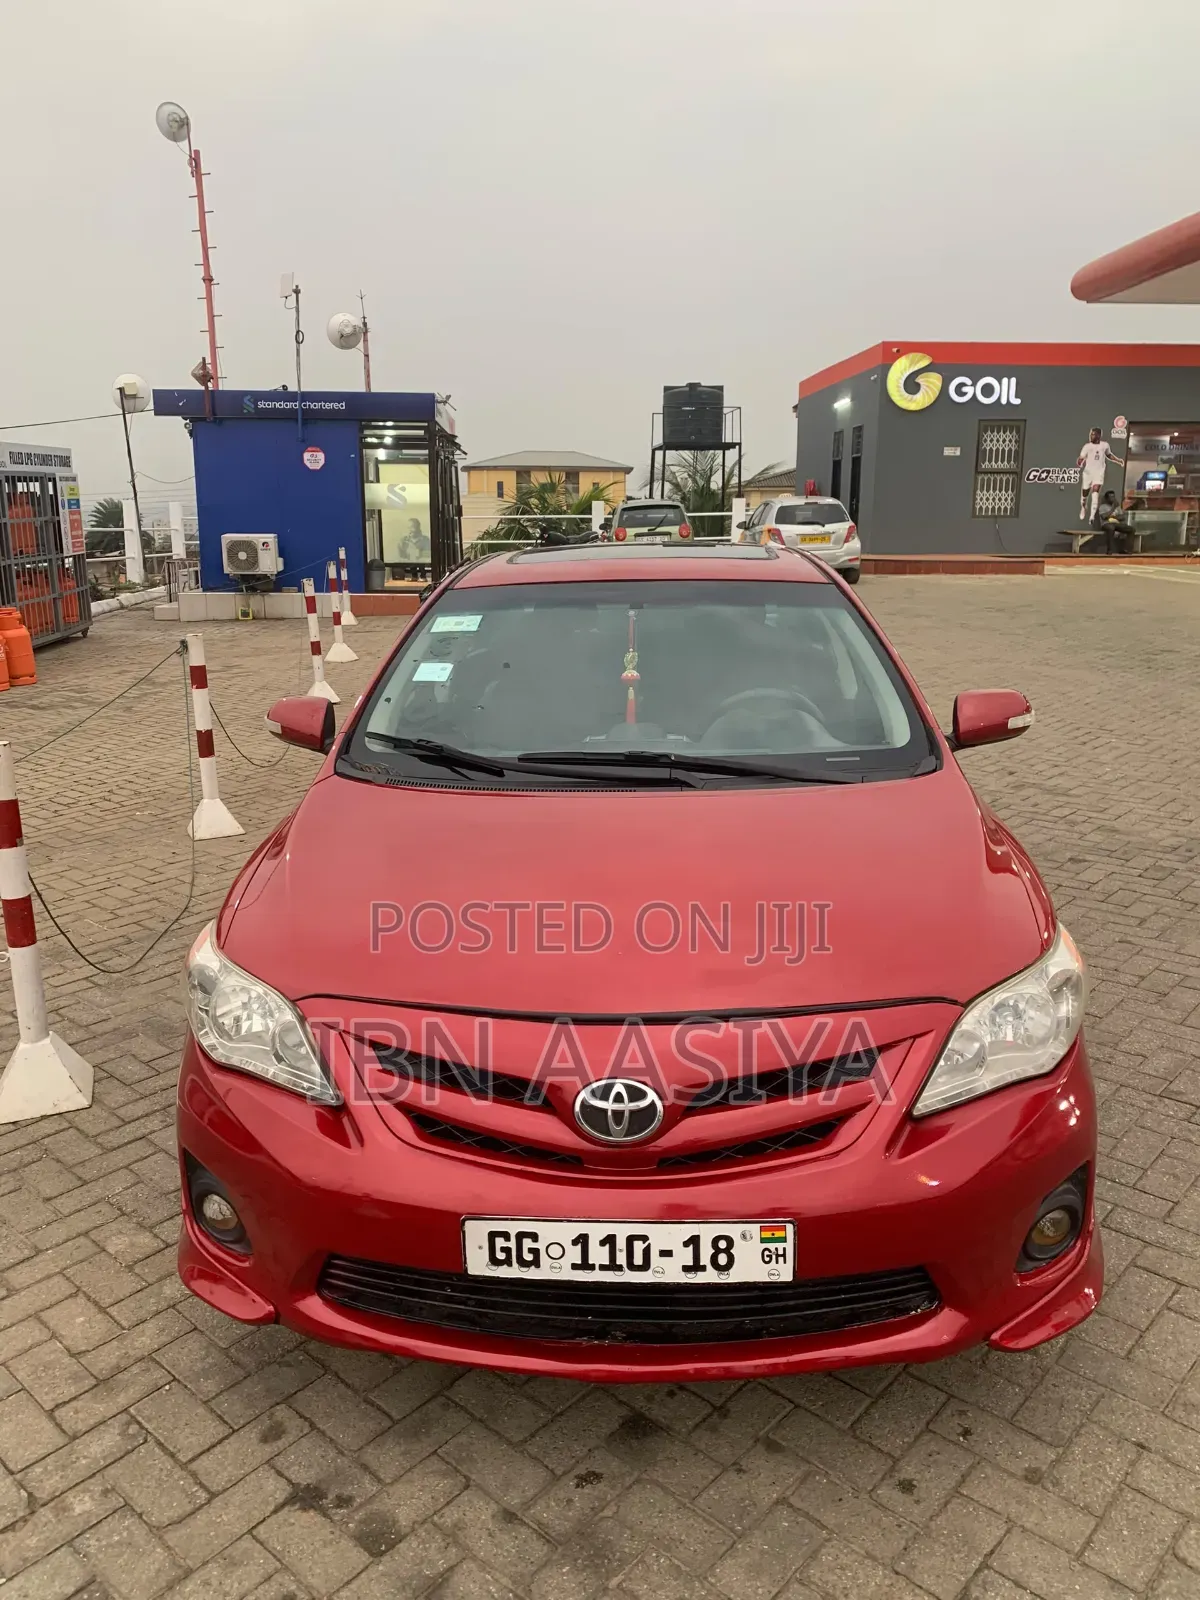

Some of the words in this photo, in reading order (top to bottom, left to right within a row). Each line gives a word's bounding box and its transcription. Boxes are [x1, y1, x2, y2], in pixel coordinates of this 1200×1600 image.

[948, 376, 1021, 405] GOIL
[257, 400, 299, 409] standard
[301, 401, 346, 410] chartered
[1144, 443, 1167, 451] COLD
[9, 451, 24, 465] FILLED
[24, 452, 34, 466] LPG
[33, 453, 54, 467] CYLINDER
[53, 454, 71, 468] STORAGE
[1025, 468, 1052, 482] GO
[1048, 475, 1078, 483] STARS
[487, 1230, 541, 1269] GG
[570, 1232, 735, 1273] 110-18
[760, 1246, 787, 1265] GH
